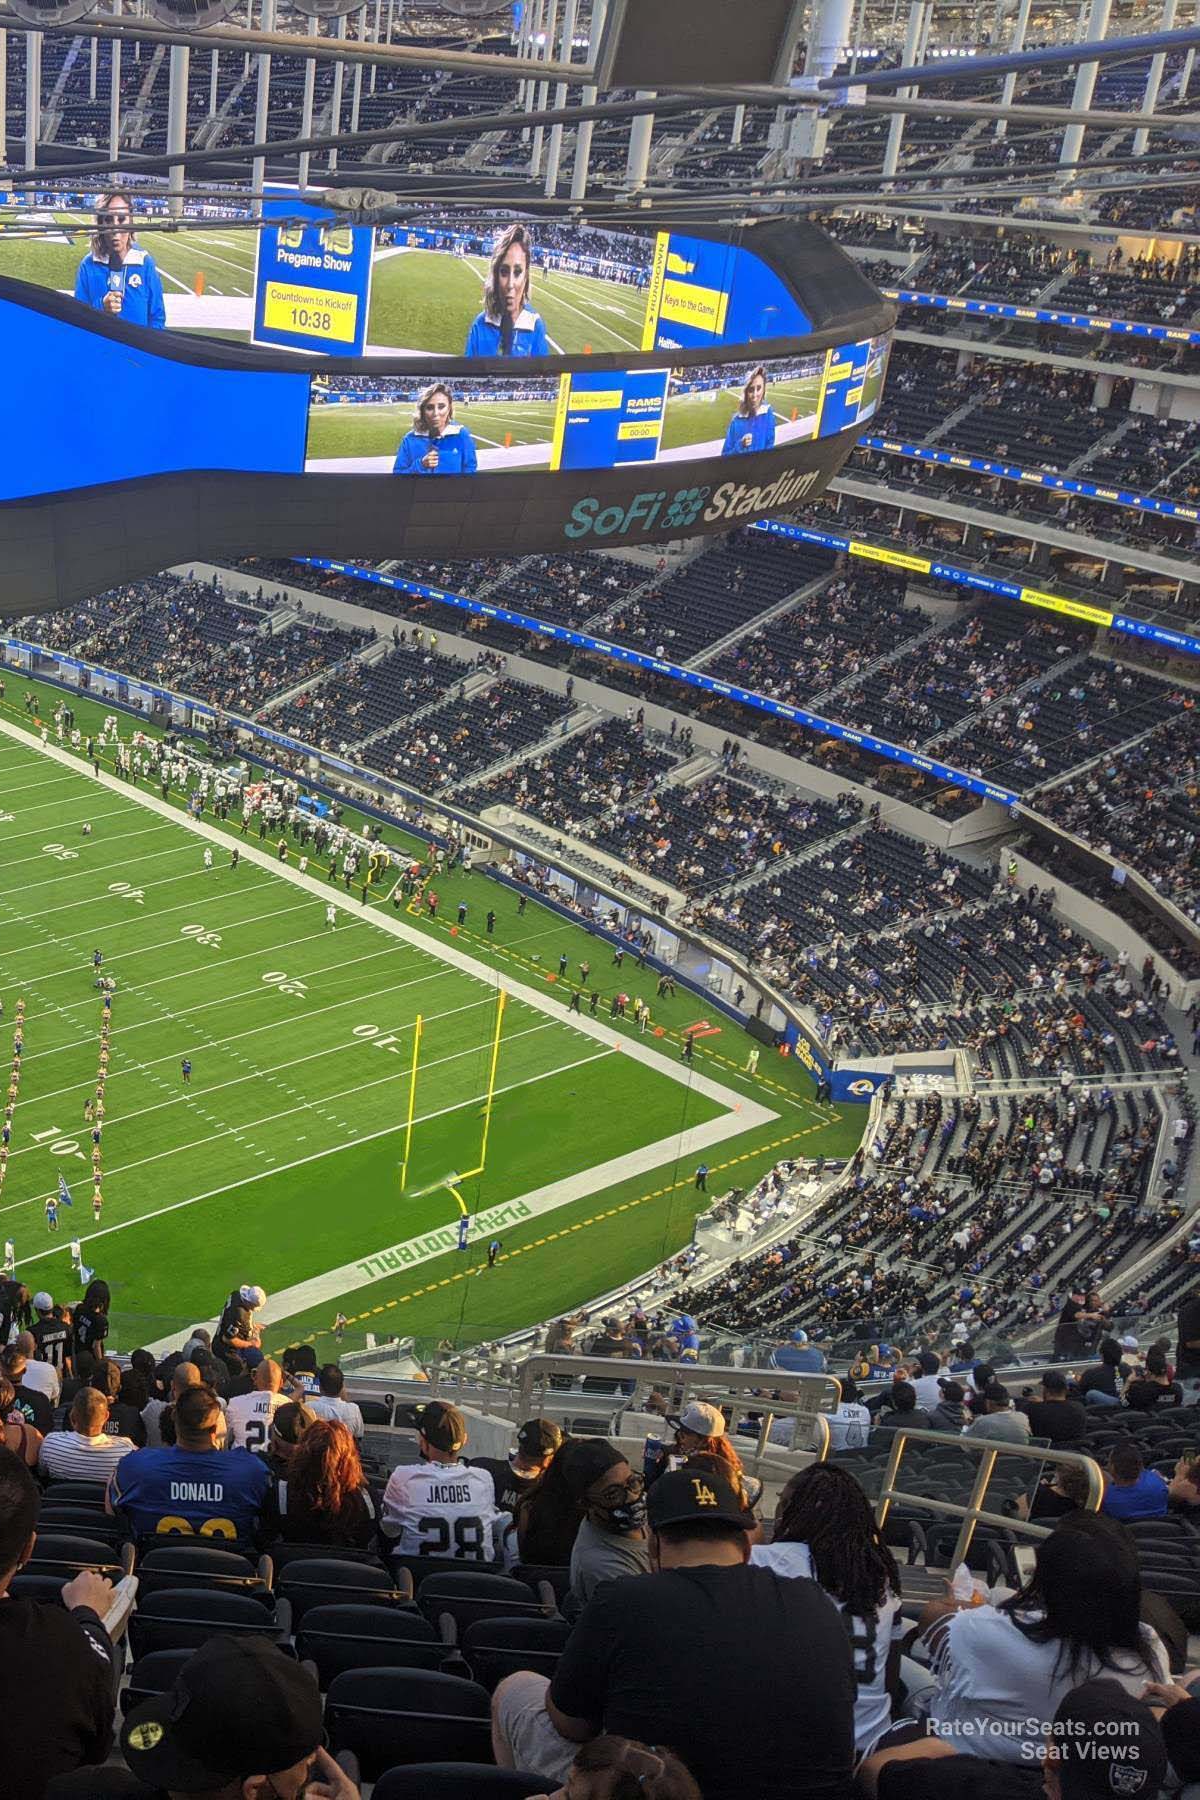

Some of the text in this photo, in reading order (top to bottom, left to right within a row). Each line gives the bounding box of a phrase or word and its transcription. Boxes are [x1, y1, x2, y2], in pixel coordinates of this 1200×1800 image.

[277, 249, 352, 272] Pregame Show
[650, 243, 664, 313] RUNDOWN
[271, 289, 352, 311] Countdown to Kickoff
[664, 294, 715, 316] Keys to the Game
[1016, 309, 1037, 317] RAMS
[291, 308, 331, 331] 10:38
[1090, 320, 1110, 328] RAMS
[1167, 329, 1190, 339] RAMS
[627, 397, 662, 407] RAMS
[951, 457, 970, 466] RAMS
[1021, 473, 1042, 482] RAMS
[1096, 489, 1118, 499] RAMS
[564, 470, 820, 538] SoFi Stadium
[1175, 508, 1197, 518] RAMS
[653, 662, 670, 671] RAMS
[713, 683, 731, 694] RAMS
[776, 707, 795, 717] RAMS
[842, 731, 862, 743] RAMS
[912, 758, 932, 770] RAMS
[985, 787, 1007, 800] RAMS
[356, 1226, 462, 1279] OOTBALL
[170, 1482, 223, 1502] DONALD
[427, 1484, 471, 1504] JACOBS
[692, 1479, 717, 1505] LA
[418, 1516, 485, 1561] 28
